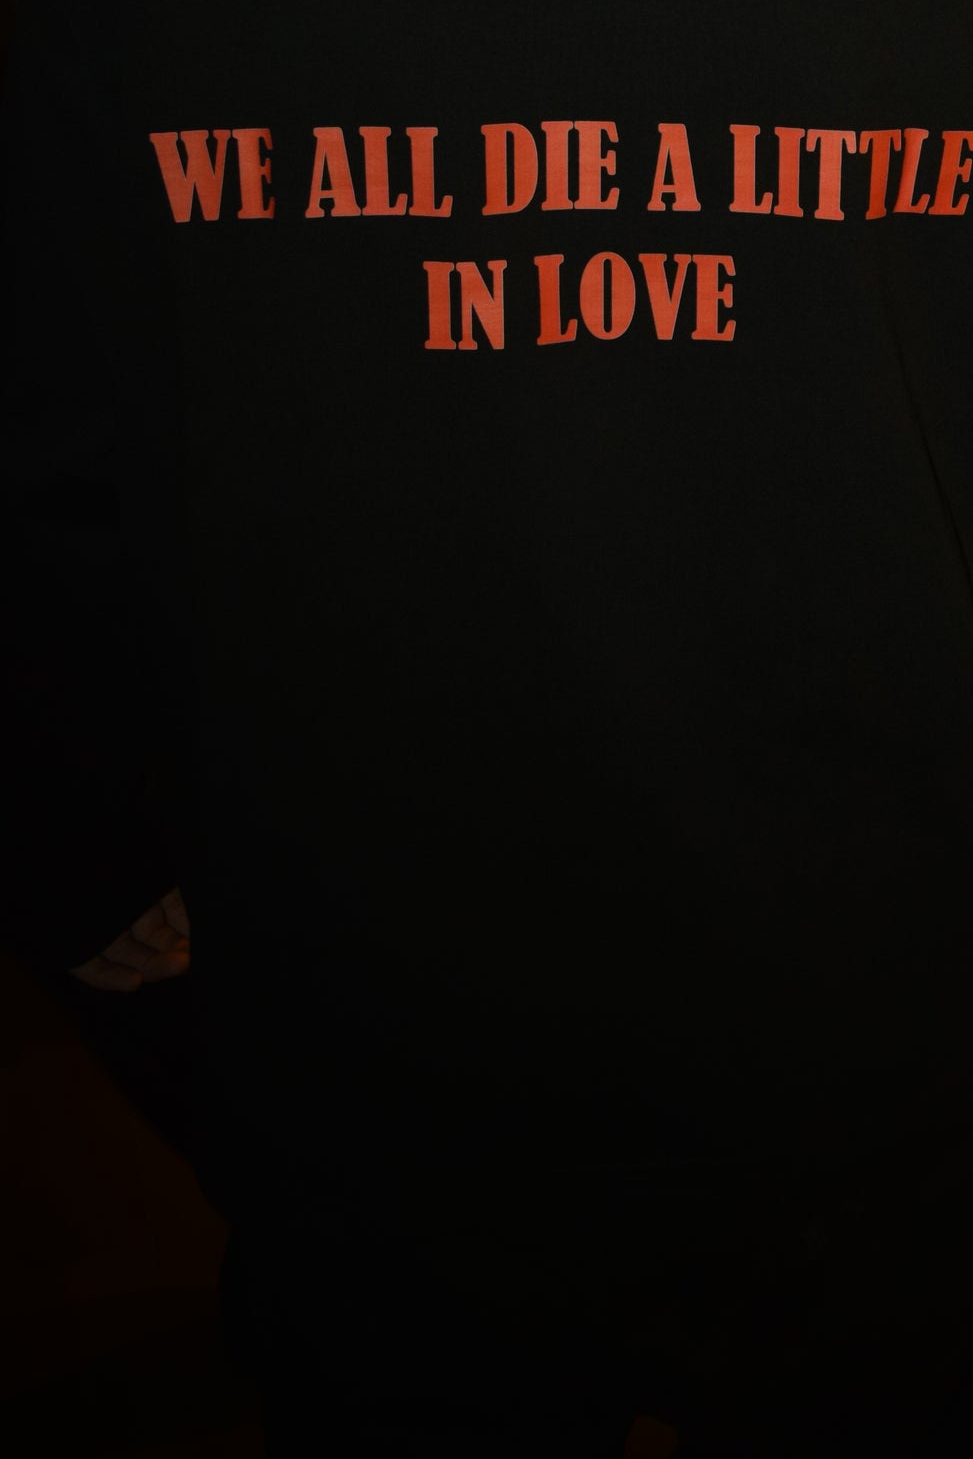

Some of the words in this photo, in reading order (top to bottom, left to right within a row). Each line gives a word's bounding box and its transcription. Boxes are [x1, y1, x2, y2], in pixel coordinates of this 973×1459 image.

[149, 127, 276, 223] WE
[304, 125, 454, 219] ALL
[480, 120, 620, 217] DIE
[646, 122, 702, 213] A
[422, 259, 507, 351] IN
[533, 251, 737, 347] LOVE
